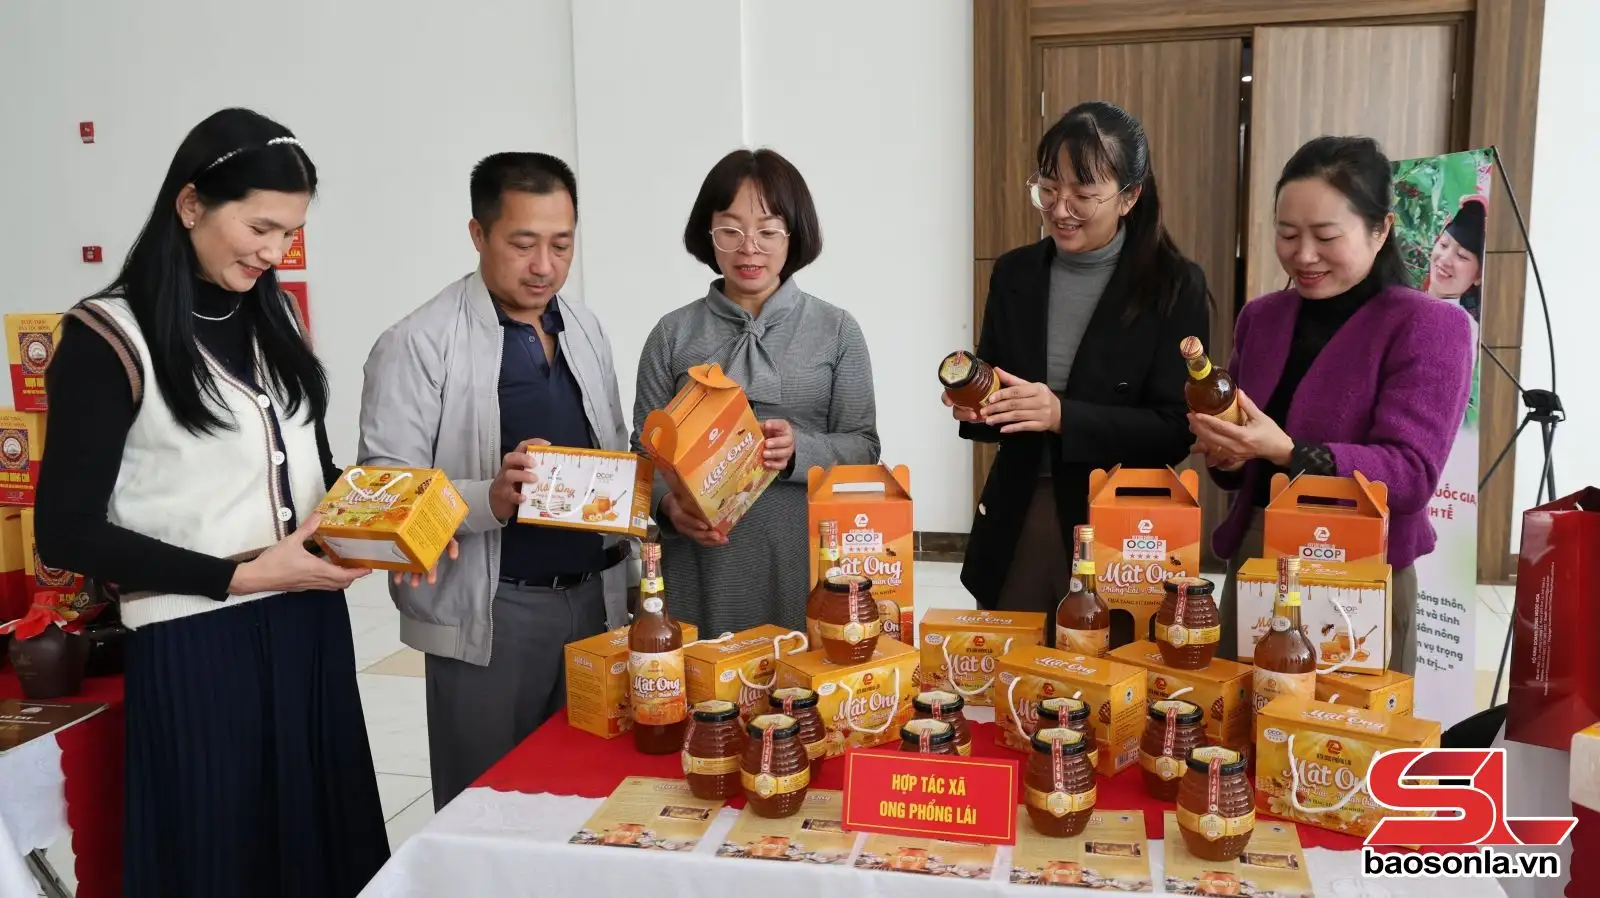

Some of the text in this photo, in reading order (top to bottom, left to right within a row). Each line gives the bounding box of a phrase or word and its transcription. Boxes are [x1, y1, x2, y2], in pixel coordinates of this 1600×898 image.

[1434, 483, 1458, 500] UỐC
[1441, 503, 1453, 520] TẾ
[845, 533, 879, 543] OCOP
[1126, 540, 1162, 550] OCOP
[1302, 547, 1341, 559] OCOP
[864, 556, 904, 580] Ong
[1441, 597, 1467, 613] thôn,
[1427, 609, 1438, 620] và
[1440, 612, 1460, 626] tỉnh
[1434, 628, 1460, 645] nông
[1424, 642, 1435, 654] vụ
[1436, 644, 1463, 662] trọng
[1281, 759, 1331, 788] Mật
[892, 773, 966, 796] HỢP TÁC XÃ
[879, 799, 977, 825] ONG PHỔNG LÁI
